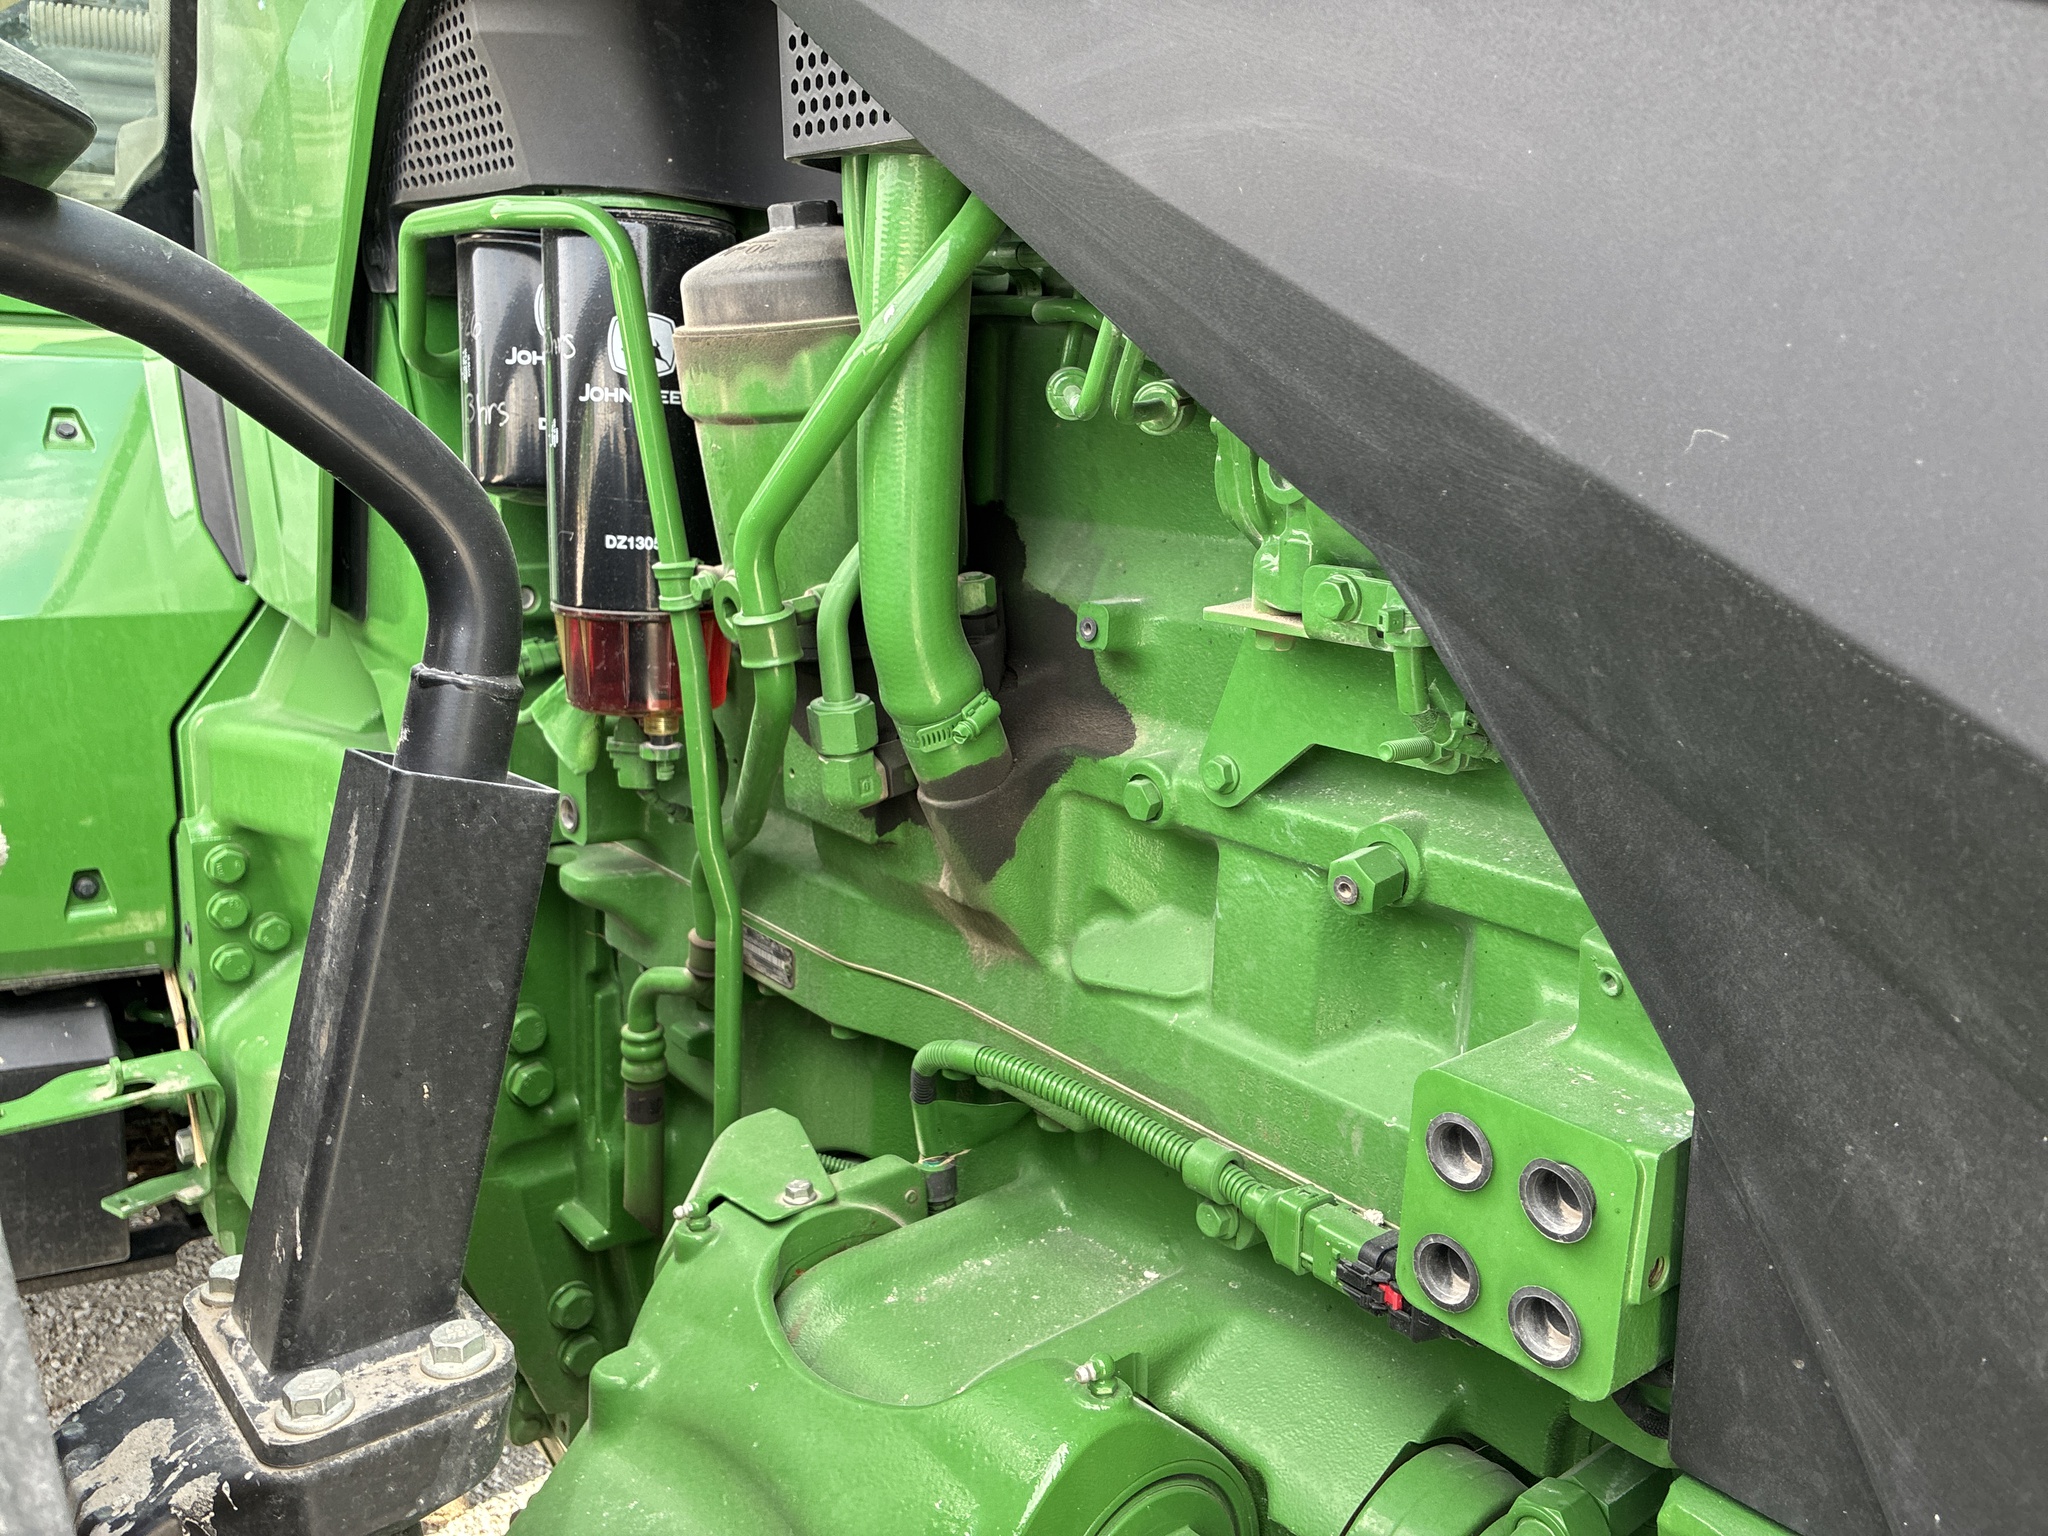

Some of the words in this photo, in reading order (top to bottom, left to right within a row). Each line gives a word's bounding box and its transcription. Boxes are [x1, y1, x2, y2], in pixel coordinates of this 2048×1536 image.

[505, 346, 546, 366] JOH
[578, 383, 633, 403] JOHN
[604, 534, 659, 551] DZ1305
